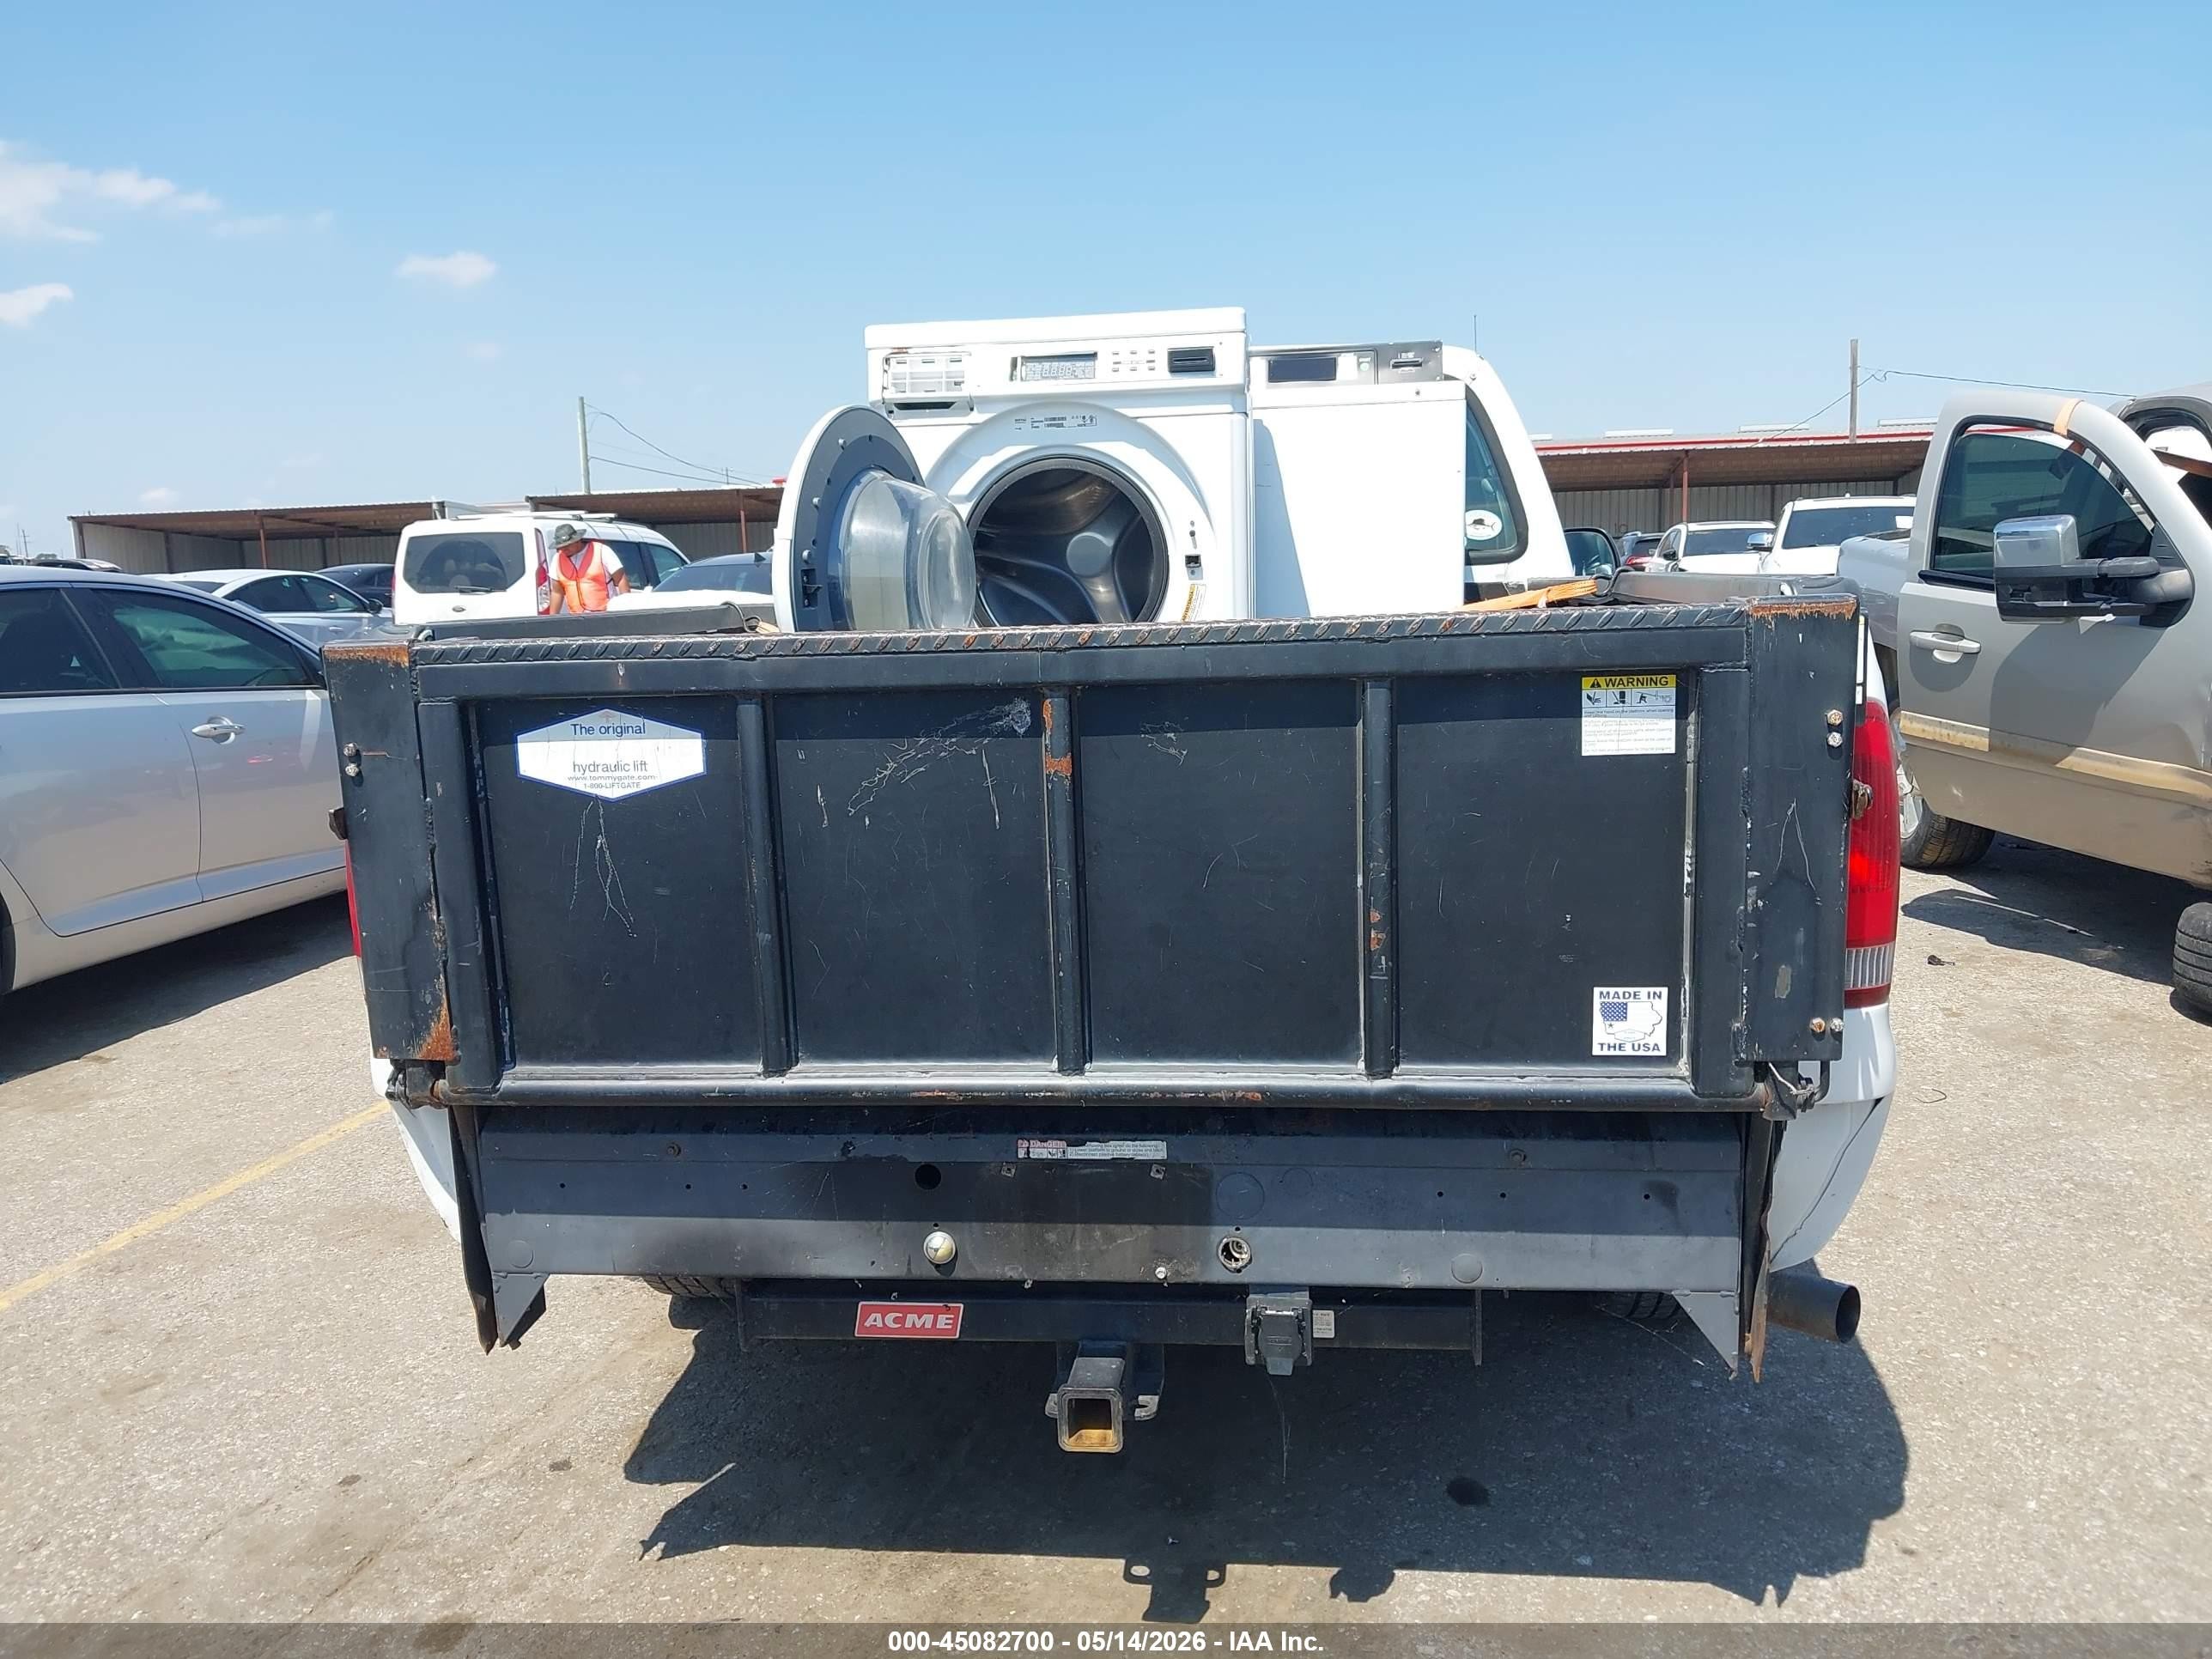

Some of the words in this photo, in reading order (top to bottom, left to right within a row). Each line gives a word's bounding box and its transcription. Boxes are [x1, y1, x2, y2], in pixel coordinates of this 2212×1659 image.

[1604, 676, 1669, 688] WARNING
[570, 723, 595, 735] The
[599, 721, 646, 737] original
[573, 760, 630, 775] hydraulic
[634, 760, 648, 773] lift
[1599, 991, 1641, 1000] MADE
[1647, 991, 1662, 1000] IN
[1597, 1042, 1626, 1051] THE
[1632, 1042, 1661, 1052] USA
[864, 1312, 954, 1329] ACME
